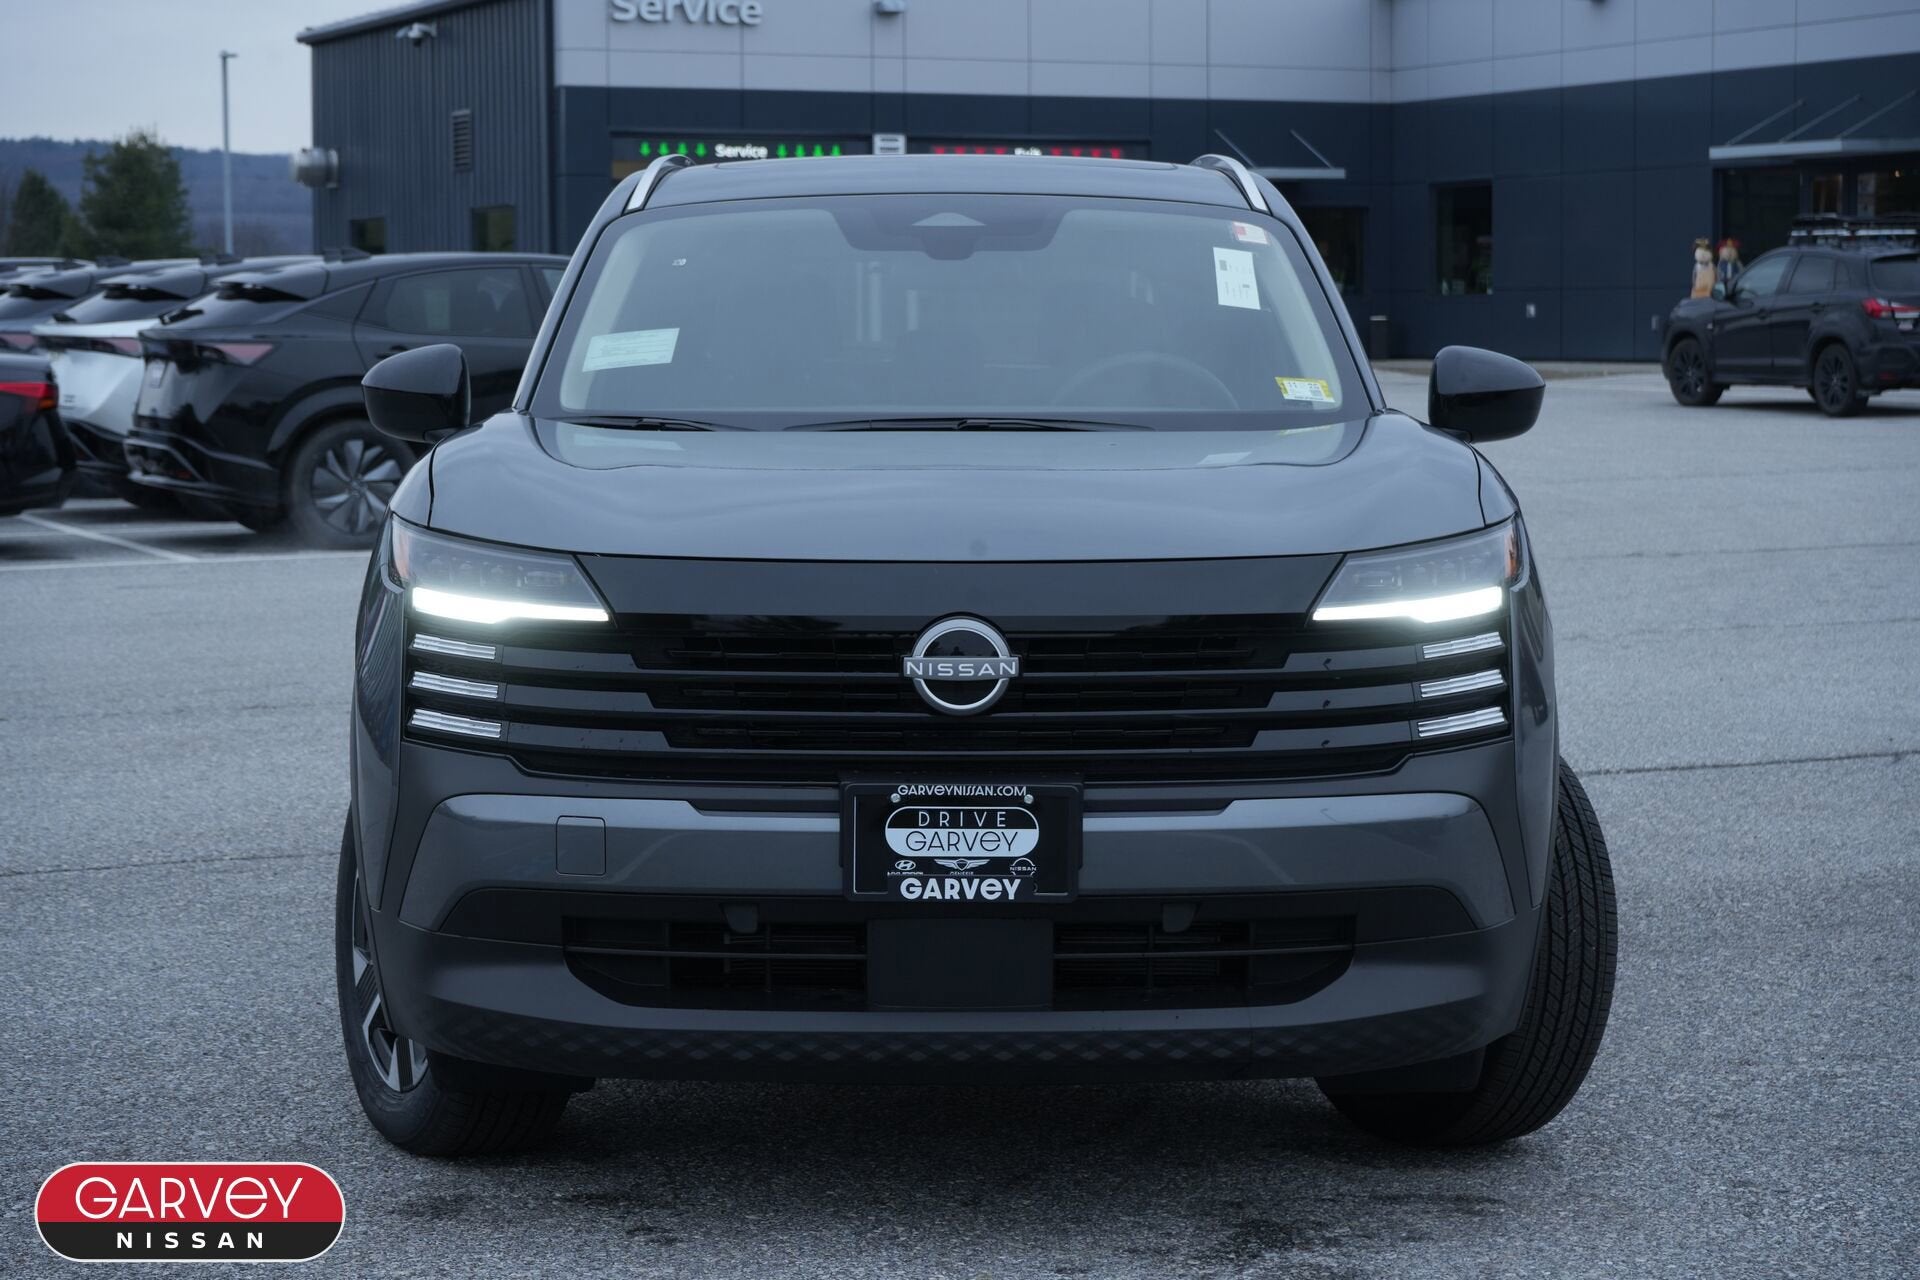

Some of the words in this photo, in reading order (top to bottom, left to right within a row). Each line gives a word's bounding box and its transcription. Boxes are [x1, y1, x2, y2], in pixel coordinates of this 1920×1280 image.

[611, 0, 763, 25] Service
[714, 143, 768, 159] Service
[906, 661, 1016, 676] NISSAN
[918, 811, 1007, 827] DRIVE
